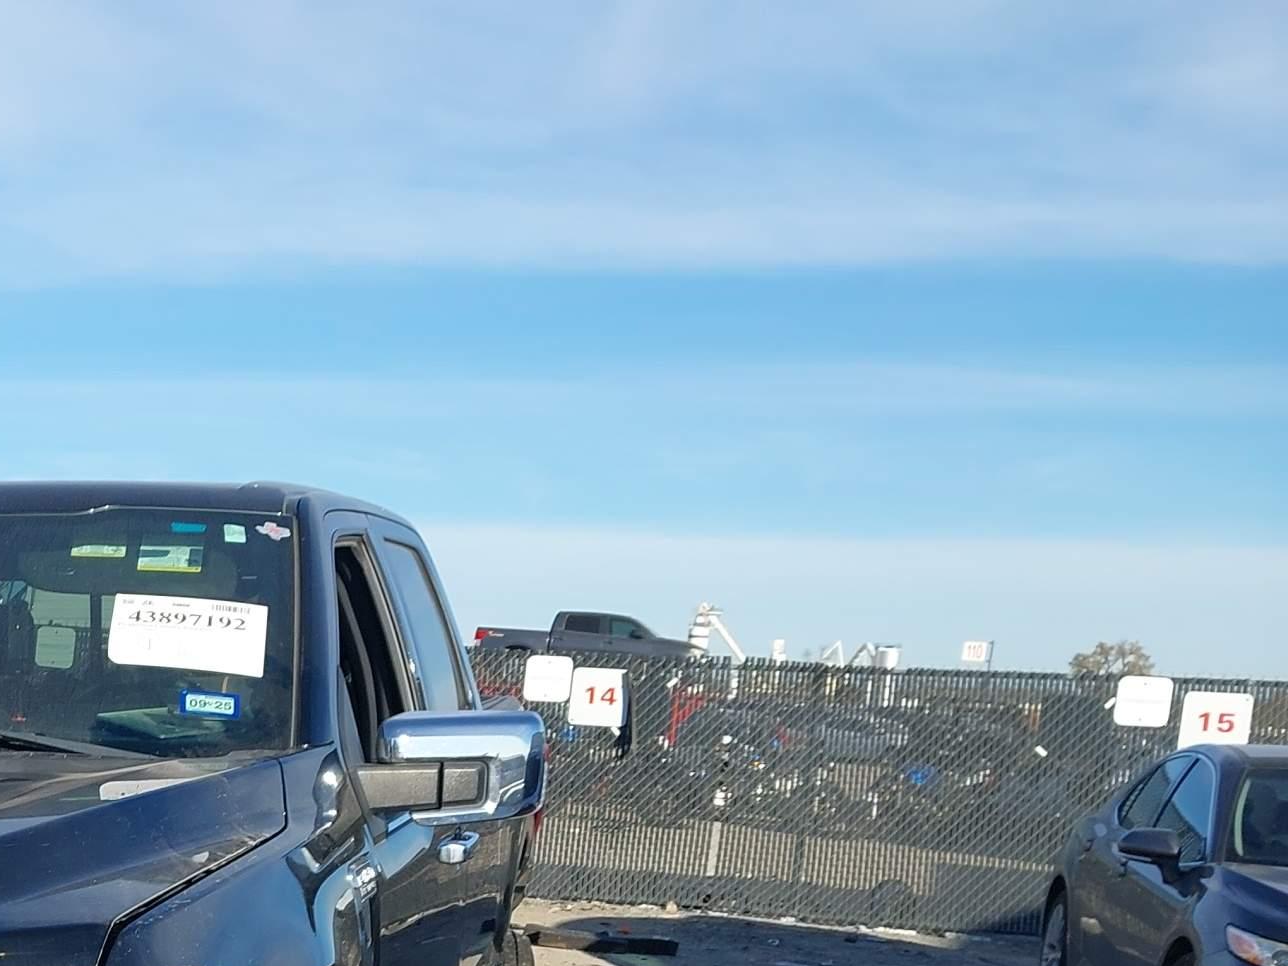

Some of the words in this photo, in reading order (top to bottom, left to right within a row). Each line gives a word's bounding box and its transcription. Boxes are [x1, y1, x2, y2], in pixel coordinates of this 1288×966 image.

[128, 609, 247, 632] 43897192
[967, 644, 984, 659] 110
[584, 686, 618, 705] 14
[1198, 711, 1236, 733] 15
